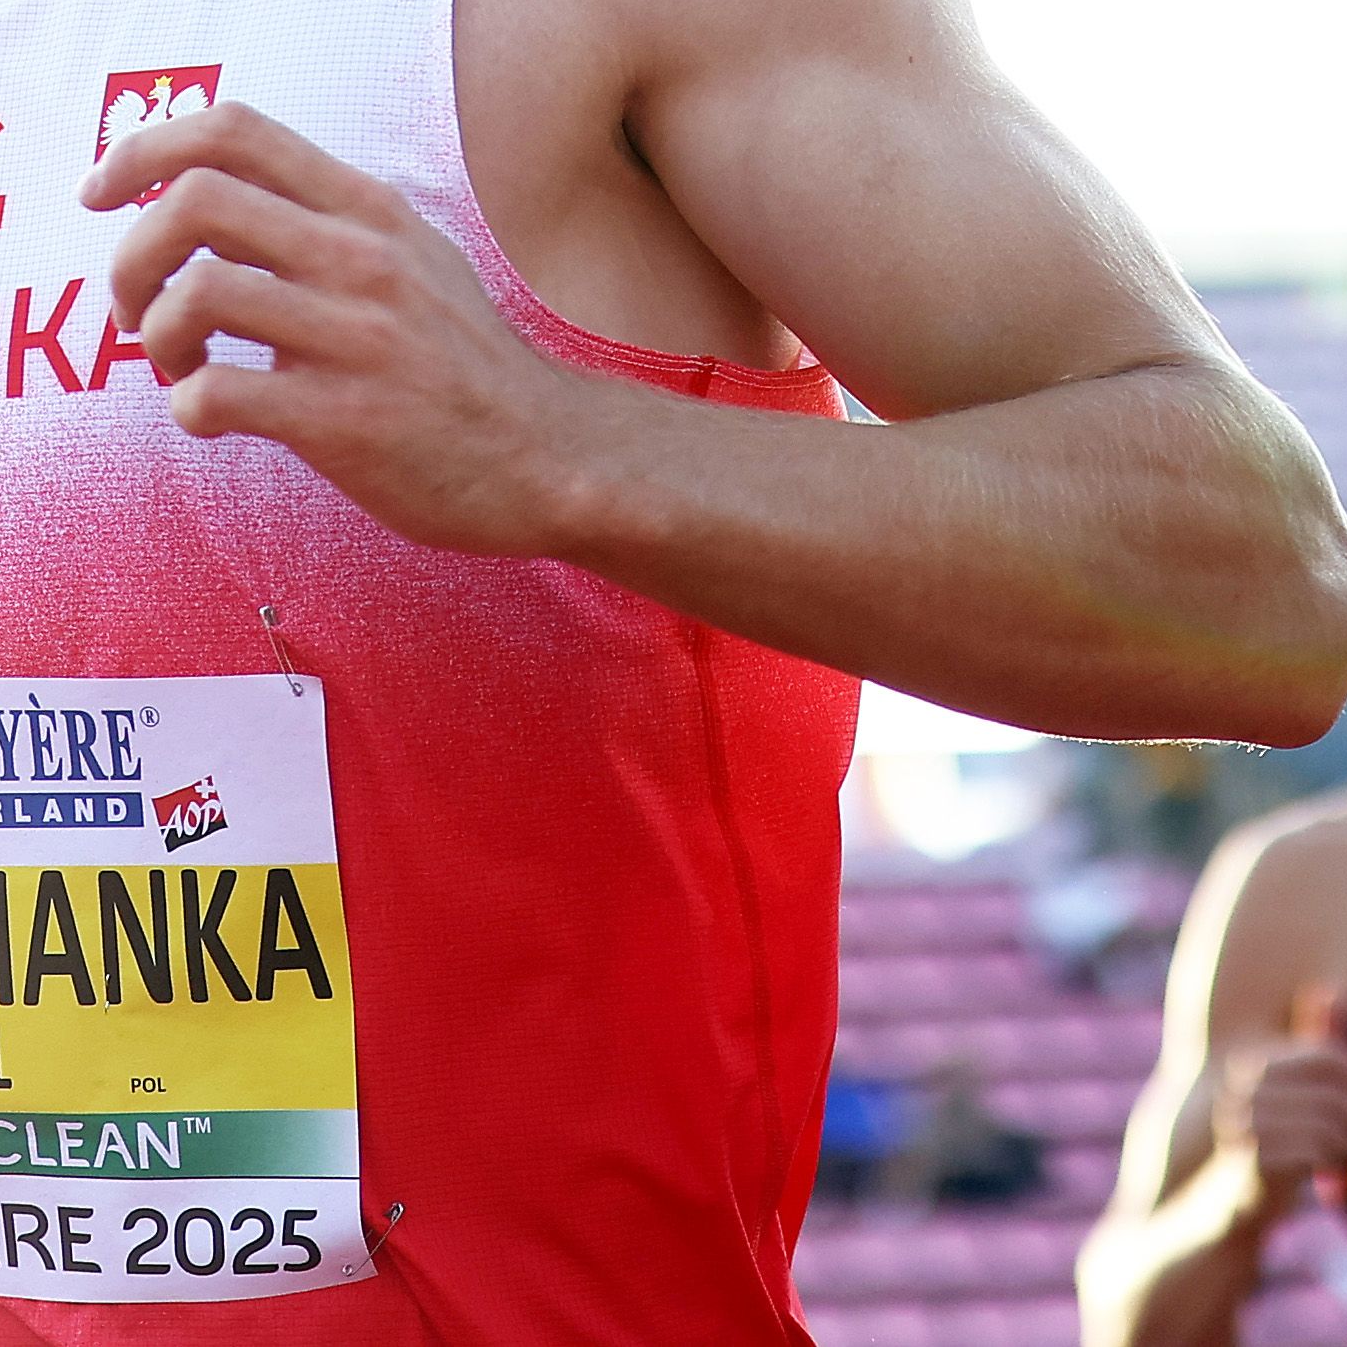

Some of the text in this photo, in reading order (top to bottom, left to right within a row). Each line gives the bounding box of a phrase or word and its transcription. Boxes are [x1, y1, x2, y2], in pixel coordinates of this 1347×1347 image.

[159, 799, 222, 841] AOP
[130, 1077, 168, 1095] POL
[121, 1208, 323, 1277] 2025
